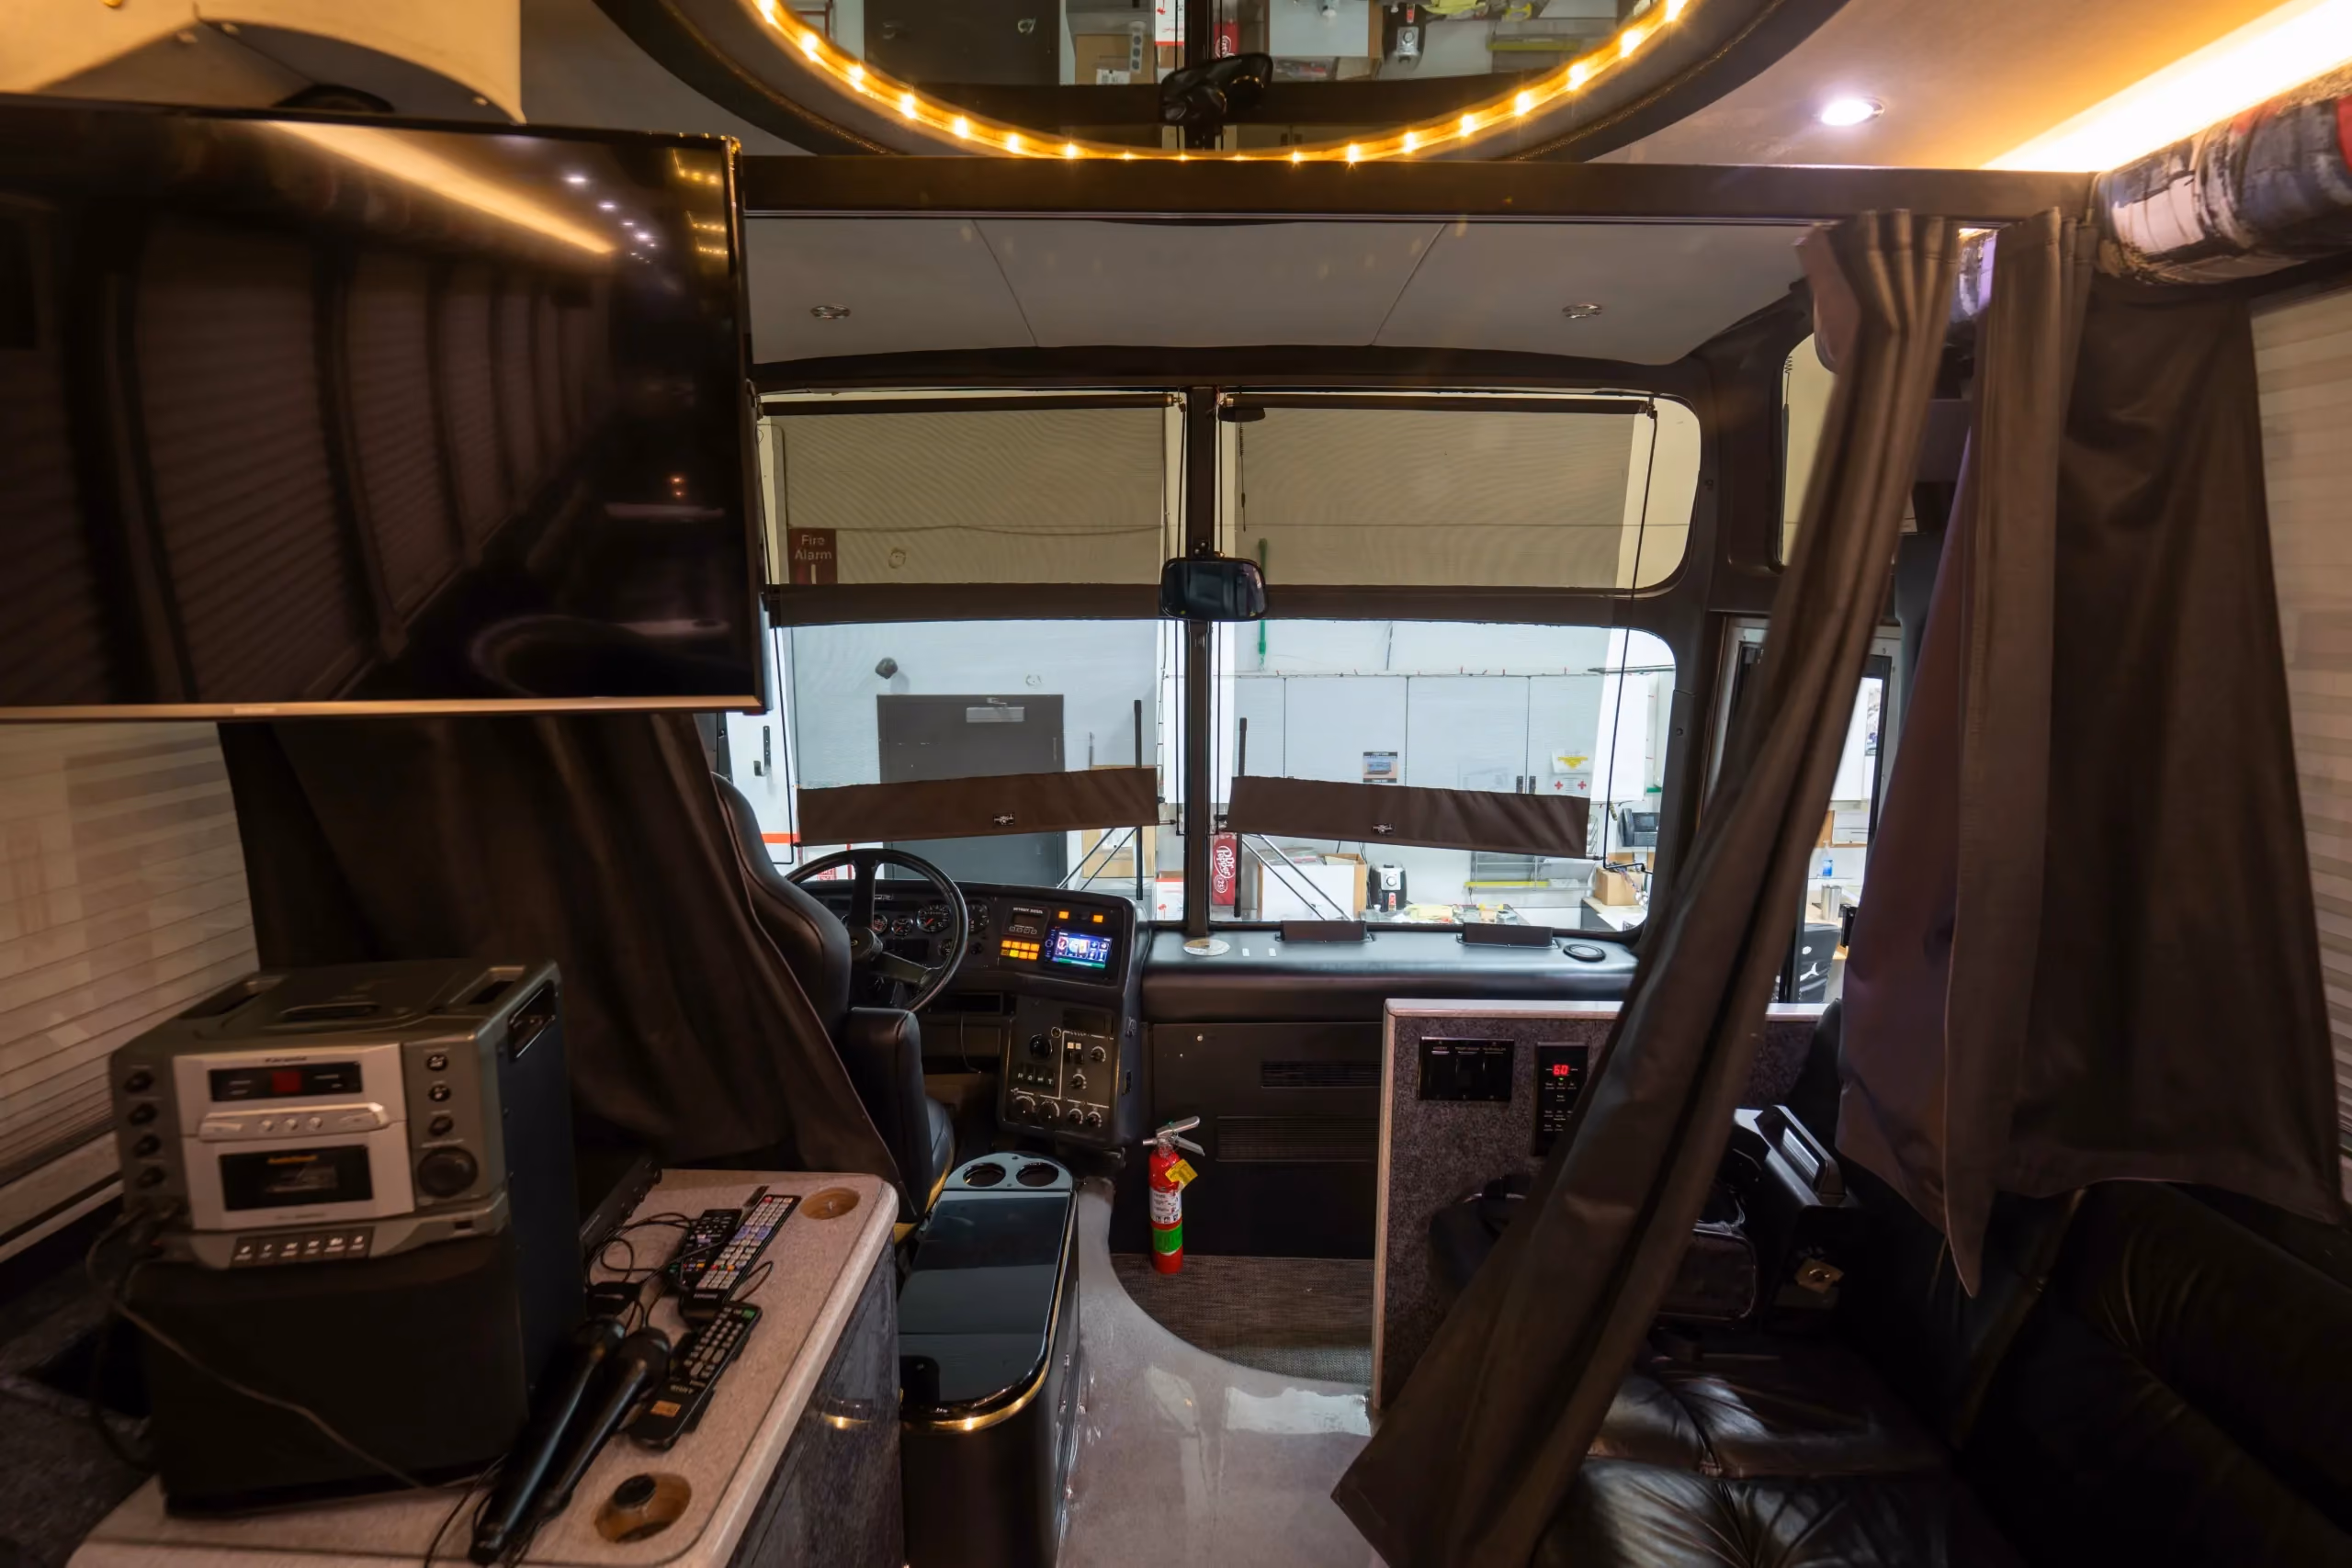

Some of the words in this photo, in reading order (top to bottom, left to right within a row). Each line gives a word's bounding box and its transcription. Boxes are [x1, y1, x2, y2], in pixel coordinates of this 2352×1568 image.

[801, 534, 825, 546] Fire
[795, 548, 832, 560] Alarm
[1216, 849, 1232, 876] Pepper
[1225, 857, 1235, 869] Dr
[1553, 1065, 1569, 1076] 60
